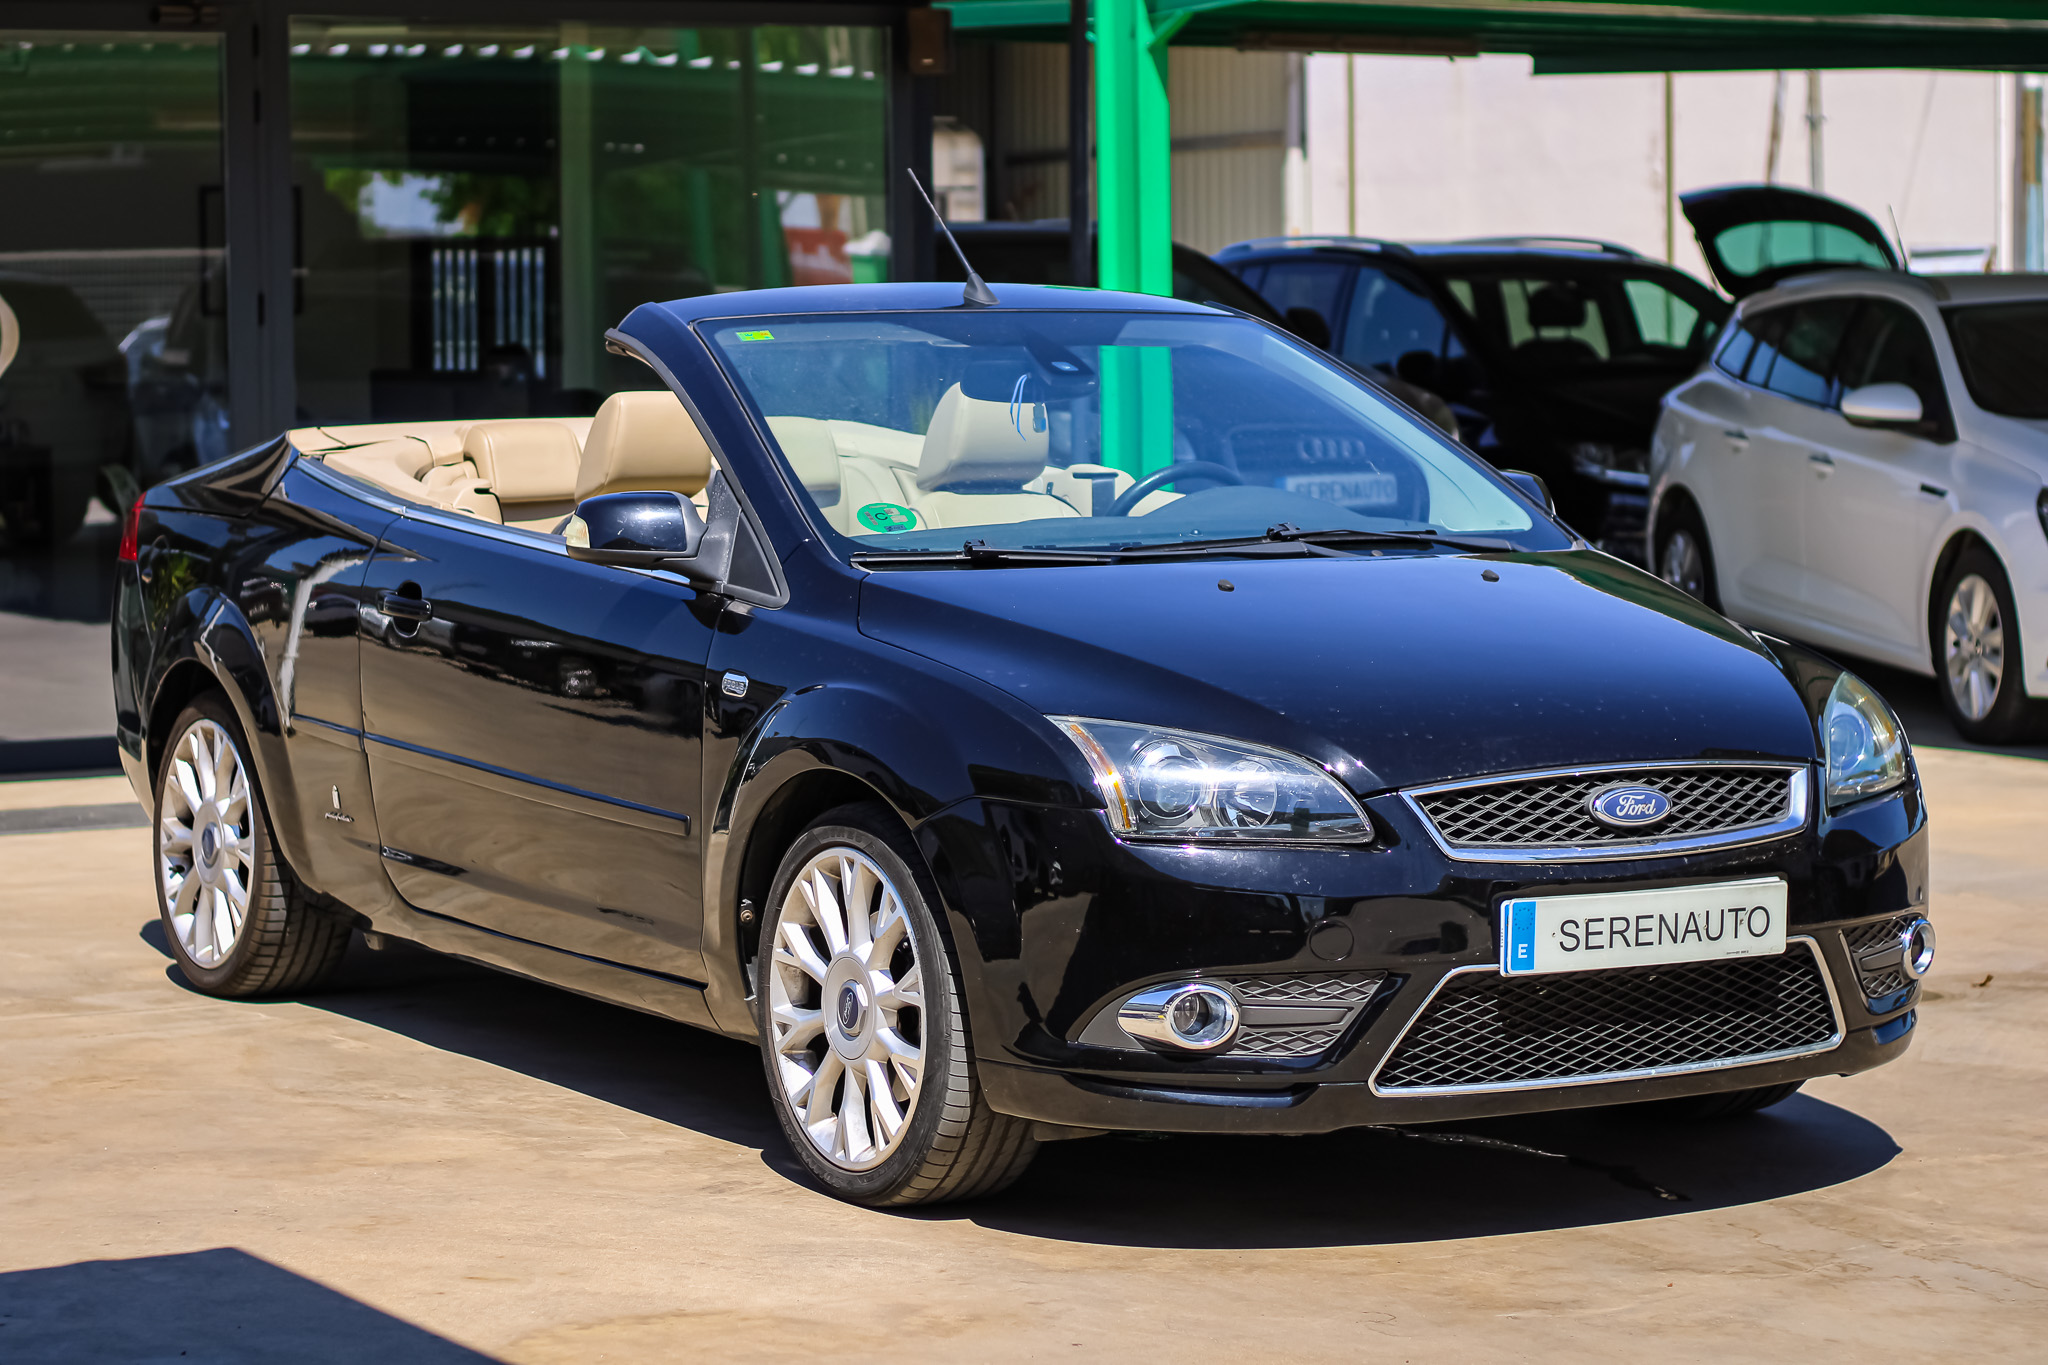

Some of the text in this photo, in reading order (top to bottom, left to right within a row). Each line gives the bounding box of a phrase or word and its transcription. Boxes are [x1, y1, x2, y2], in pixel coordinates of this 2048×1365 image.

[1616, 794, 1656, 816] Ford
[1559, 905, 1771, 952] SERENAUTO
[1517, 943, 1529, 959] E
